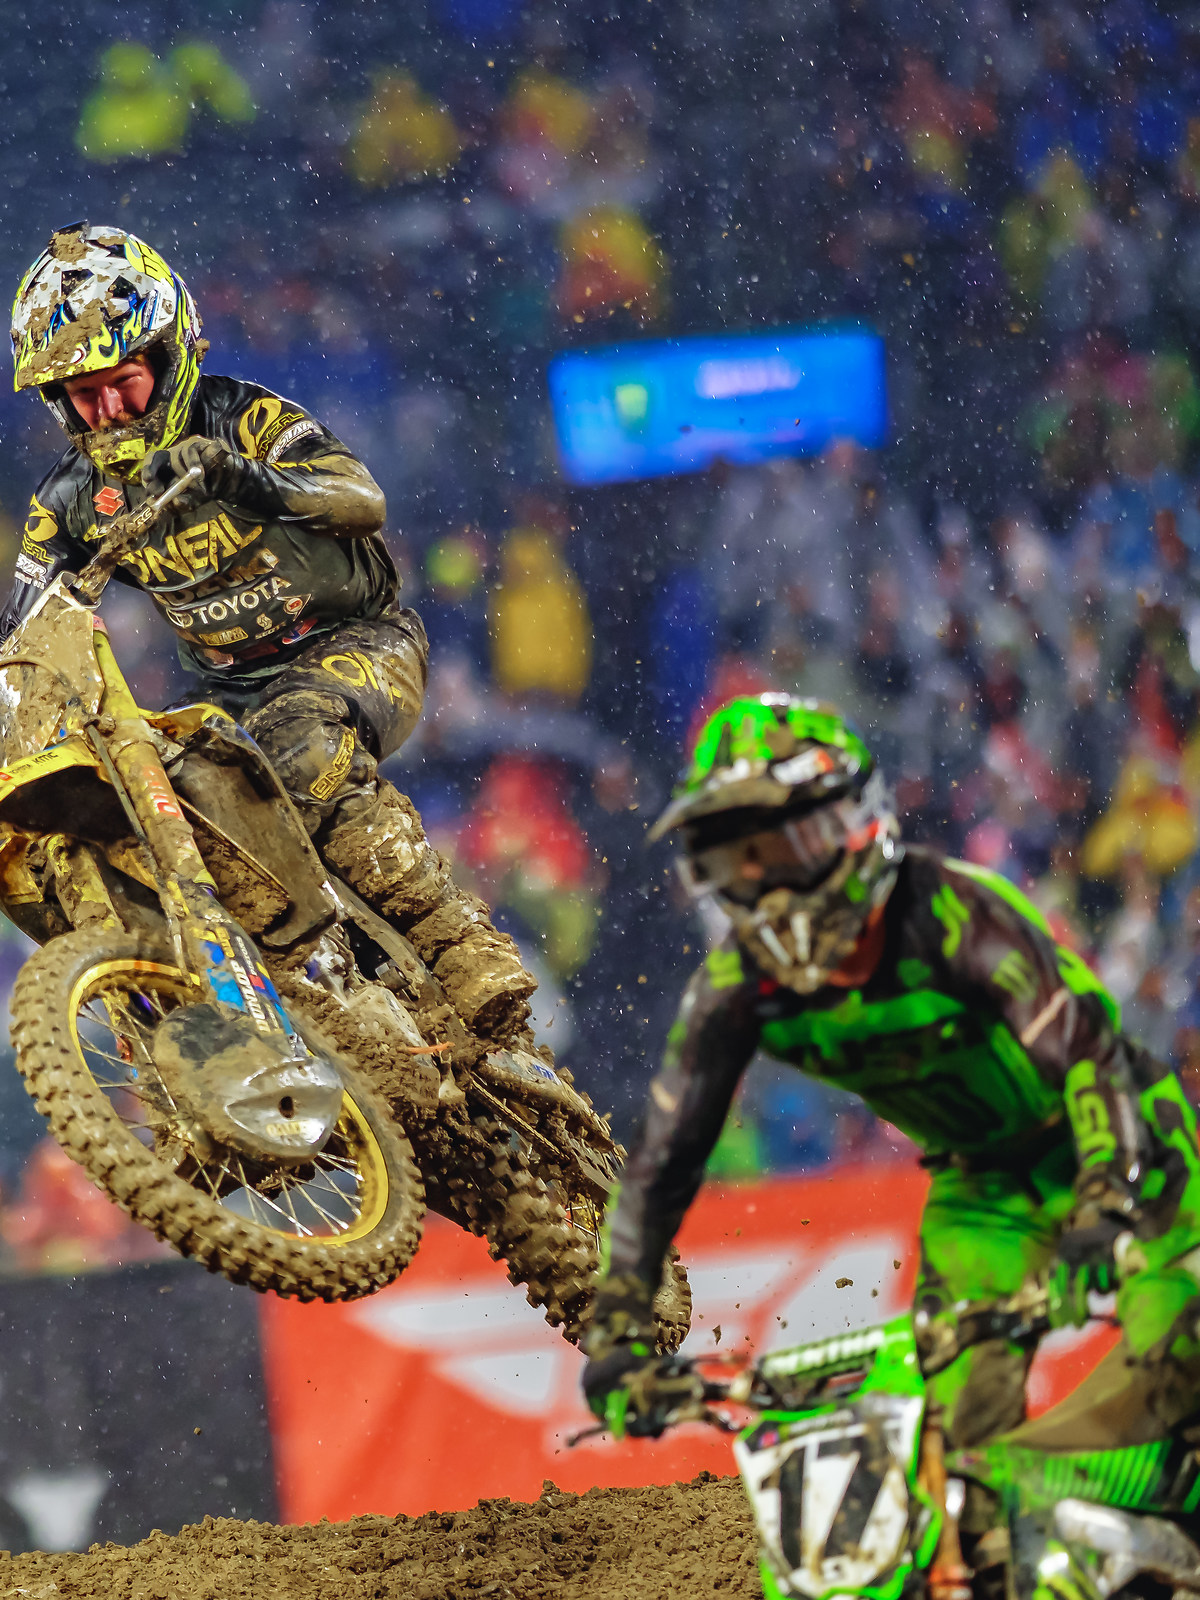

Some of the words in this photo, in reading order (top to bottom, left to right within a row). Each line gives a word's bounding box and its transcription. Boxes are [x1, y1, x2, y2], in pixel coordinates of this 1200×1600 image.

[192, 576, 292, 625] TOYOTA
[230, 959, 271, 1032] DUNLOP
[761, 1436, 892, 1571] 17
